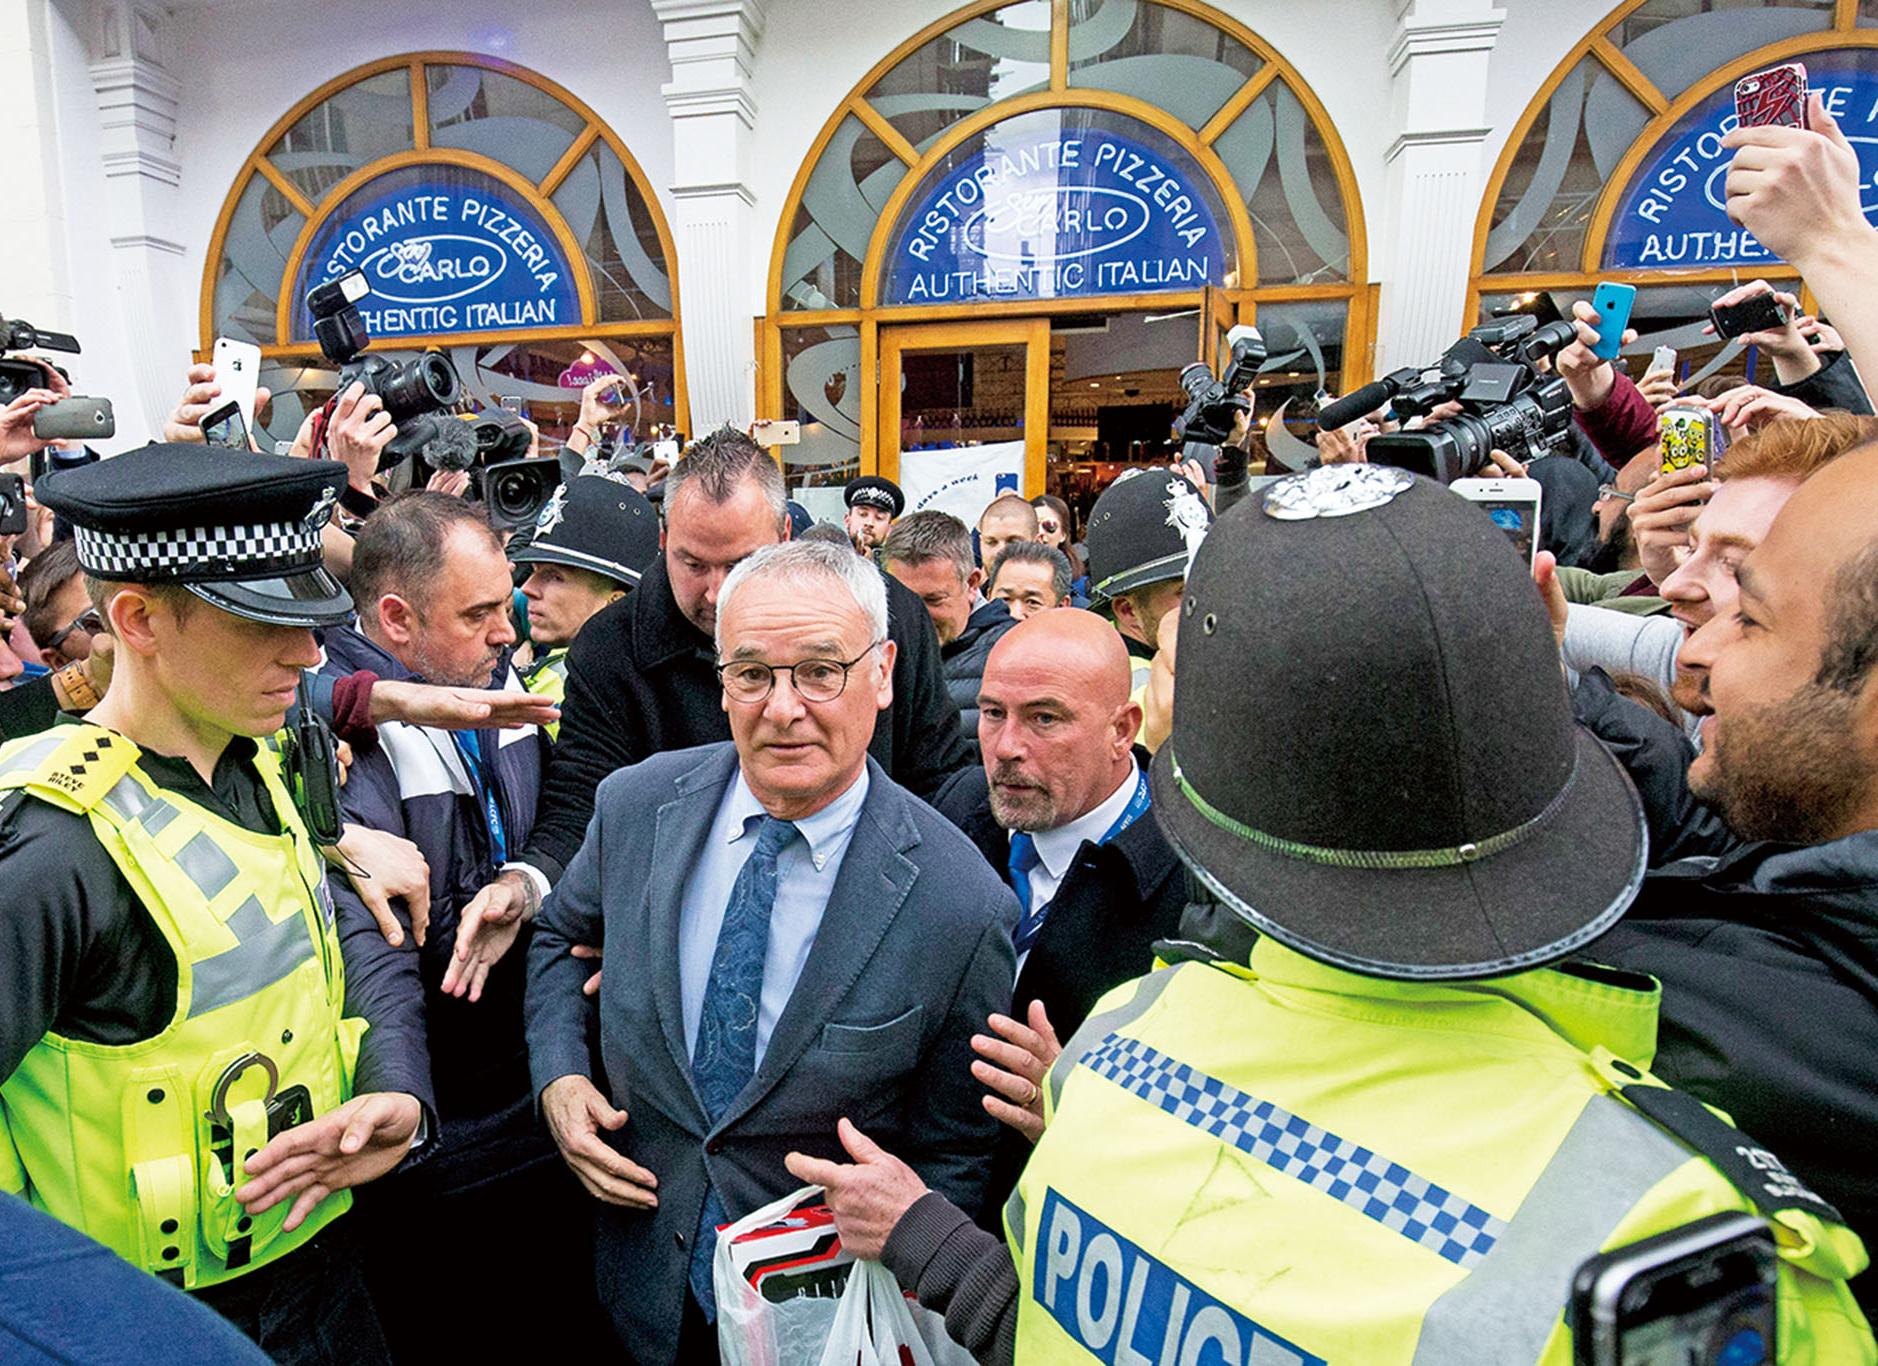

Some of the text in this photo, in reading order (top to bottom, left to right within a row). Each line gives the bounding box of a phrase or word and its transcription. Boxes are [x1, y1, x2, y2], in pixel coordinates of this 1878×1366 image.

[908, 140, 1208, 262] RISTORANTE PIZZERIA
[1017, 207, 1128, 237] CARLO
[323, 196, 558, 293] STORANTE PIZZERIA
[399, 255, 490, 283] CARLO
[907, 255, 1208, 299] AUTHENTIC ITALIAN
[465, 298, 556, 328] ITALIAN
